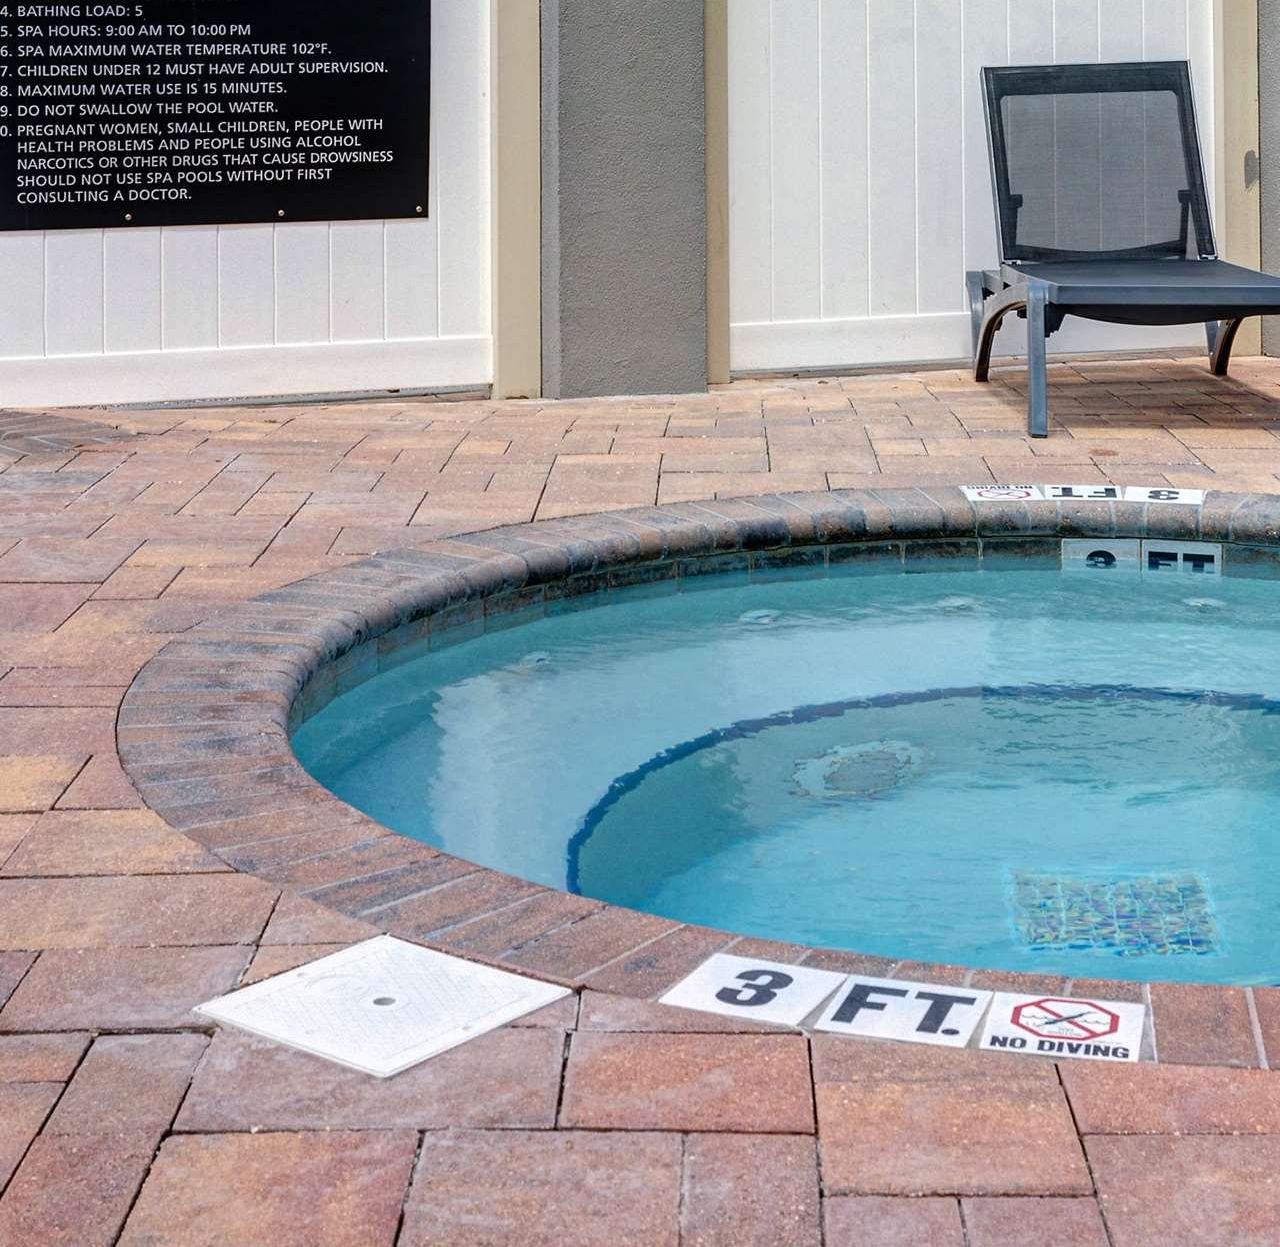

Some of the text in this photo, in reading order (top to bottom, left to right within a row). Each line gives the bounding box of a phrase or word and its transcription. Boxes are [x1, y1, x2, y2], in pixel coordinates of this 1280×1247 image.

[0, 5, 143, 18] 4. BATHING LOAD: 5
[0, 24, 251, 38] 5. SPA HOURS: 9:00 AM TO 10:00 PM
[0, 42, 332, 57] 6. SPA MAXIMUM WATER TEMPERATURE 102°F.
[0, 61, 388, 77] 7. CHILDREN UNDER 12 MUST HAVE ADULT SUPERVISION.
[0, 81, 287, 97] 8. MAXIMUM WATER USE IS 15 MINUTES.
[0, 101, 278, 117] 9. DO NOT SWALLOW THE POOL WATER.
[17, 123, 96, 137] PREGNANT
[99, 122, 162, 136] WOMEN,
[167, 122, 214, 134] SMALL
[217, 120, 290, 134] CHILDREN,
[294, 119, 344, 132] PEOPLE
[347, 118, 383, 131] WITH
[17, 135, 362, 154] HEALTH PROBLEMS AND PEOPLE USING ALCOHOL
[17, 150, 394, 170] NARCOTICS OR OTHER DRUGS THAT CAUSE DROWSINESS
[16, 168, 333, 187] SHOULD NOT USE SPA POOLS WITHOUT FIRST
[16, 188, 192, 204] CONSULTING A DOCTOR.
[715, 968, 975, 1036] 3 FT.
[989, 1035, 1130, 1059] NO DIVING
